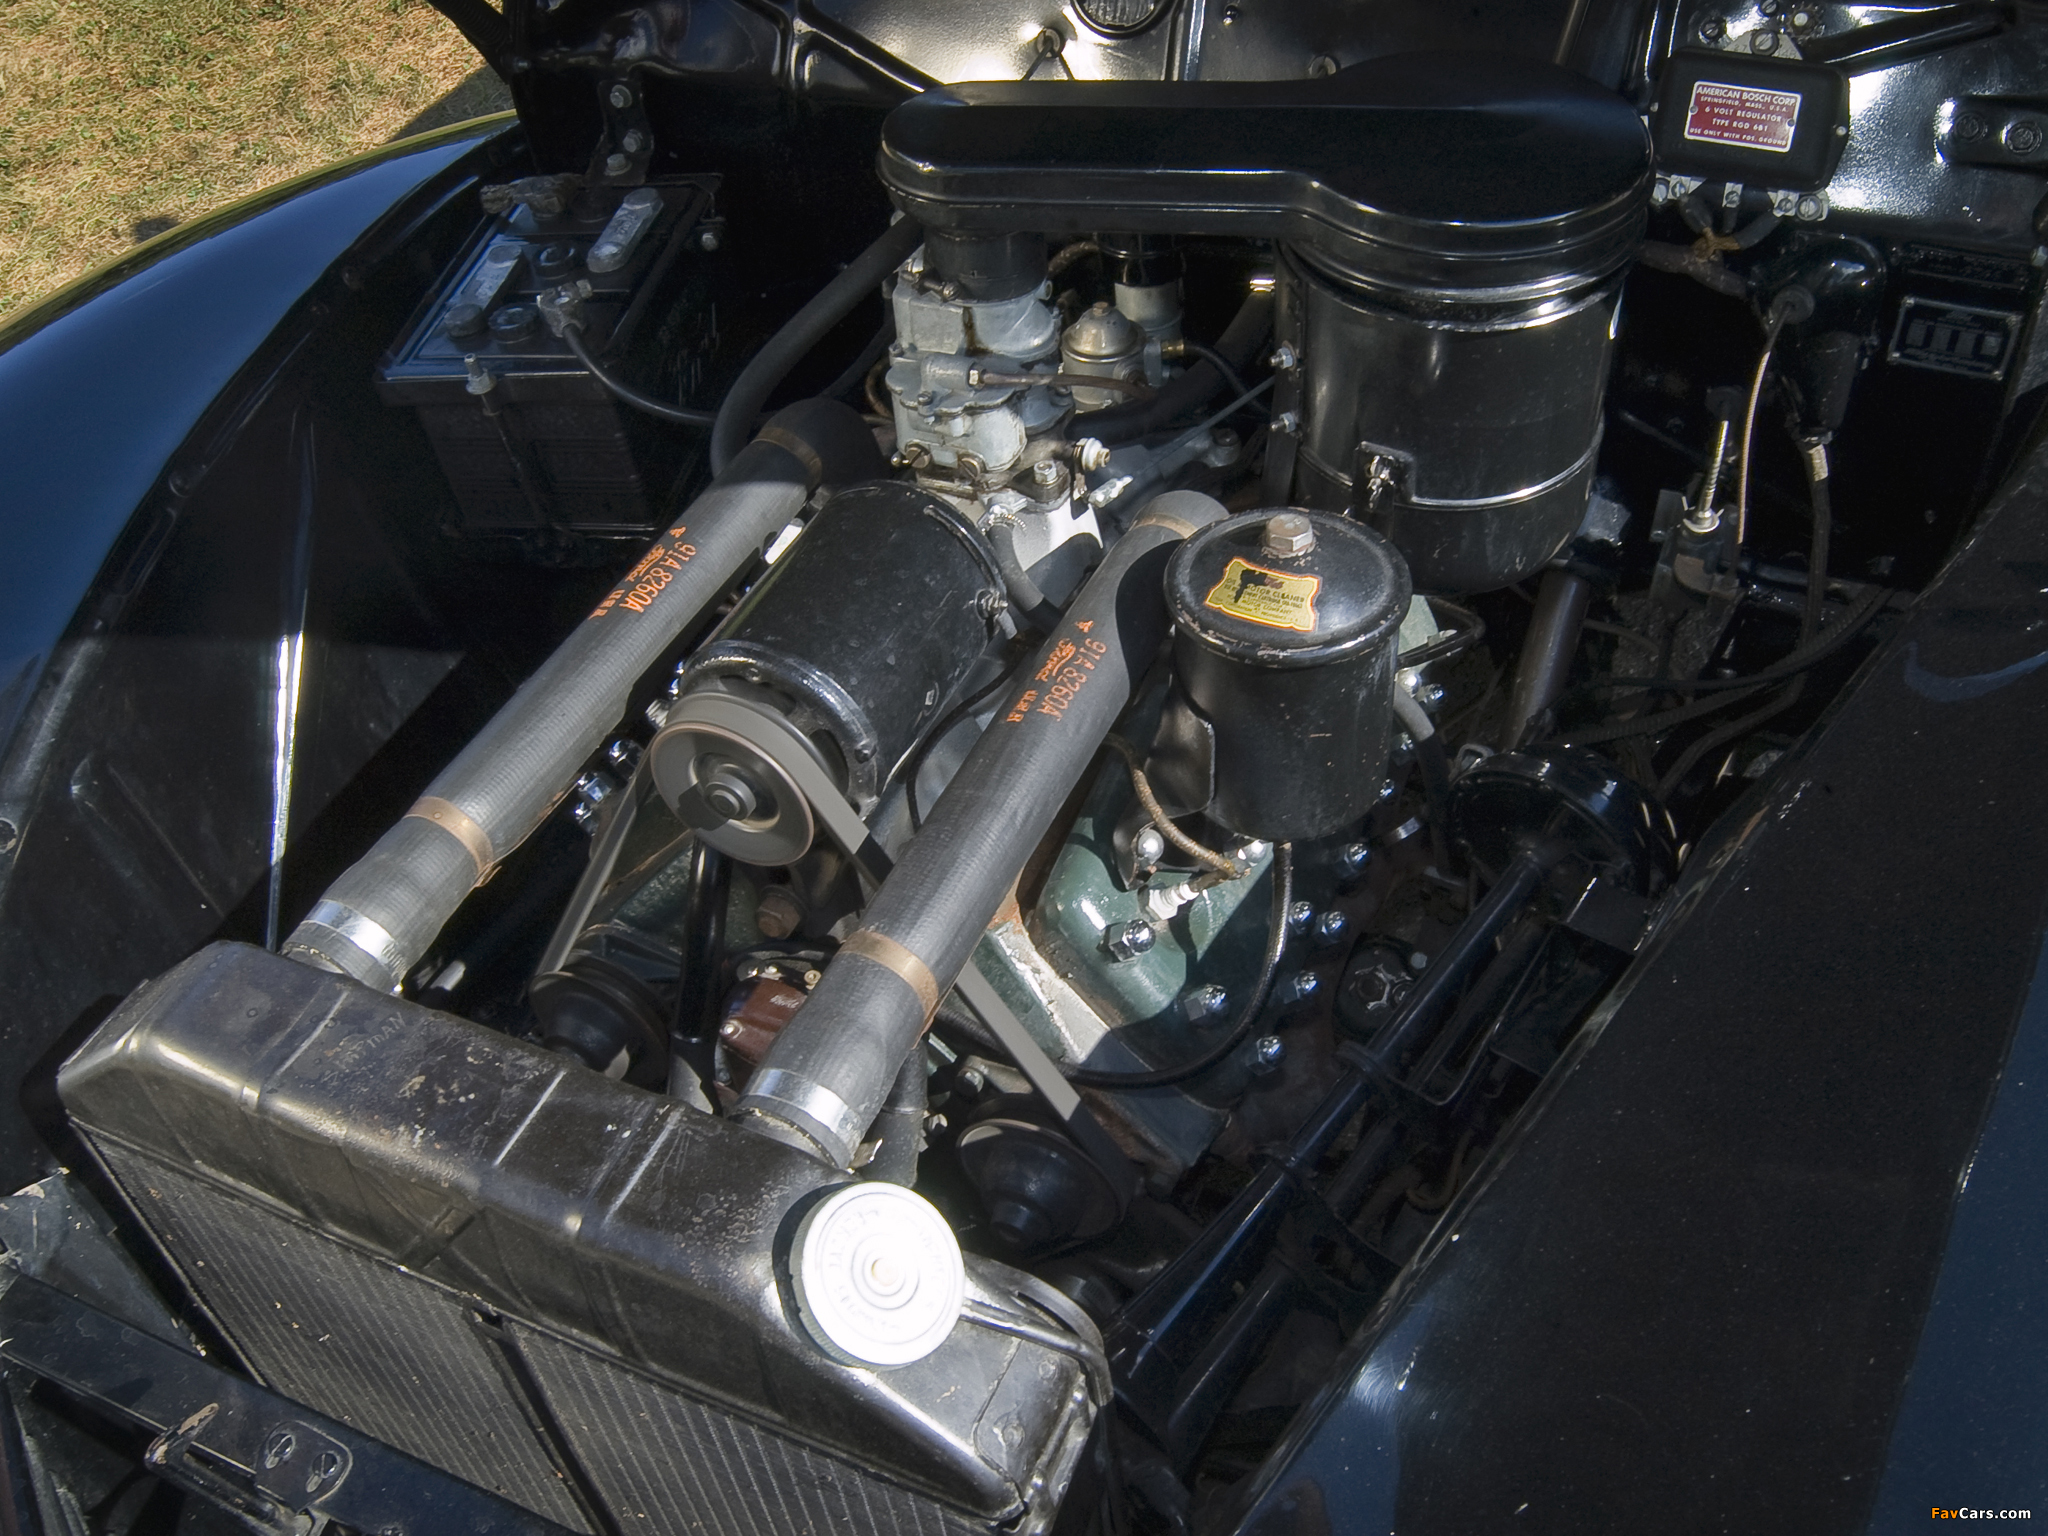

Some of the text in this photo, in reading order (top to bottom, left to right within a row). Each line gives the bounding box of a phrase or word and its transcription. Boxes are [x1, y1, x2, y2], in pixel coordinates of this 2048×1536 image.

[1696, 85, 1797, 107] AMERICAN BOSCH CORP.
[1700, 95, 1741, 107] SPRINGFIELD,
[1713, 106, 1733, 116] VOLT
[1736, 110, 1781, 122] REGULATOR
[1712, 118, 1729, 127] TYPE
[1732, 120, 1750, 129] RGD
[1689, 127, 1787, 146] USE ONLY WITH POS. GROUND
